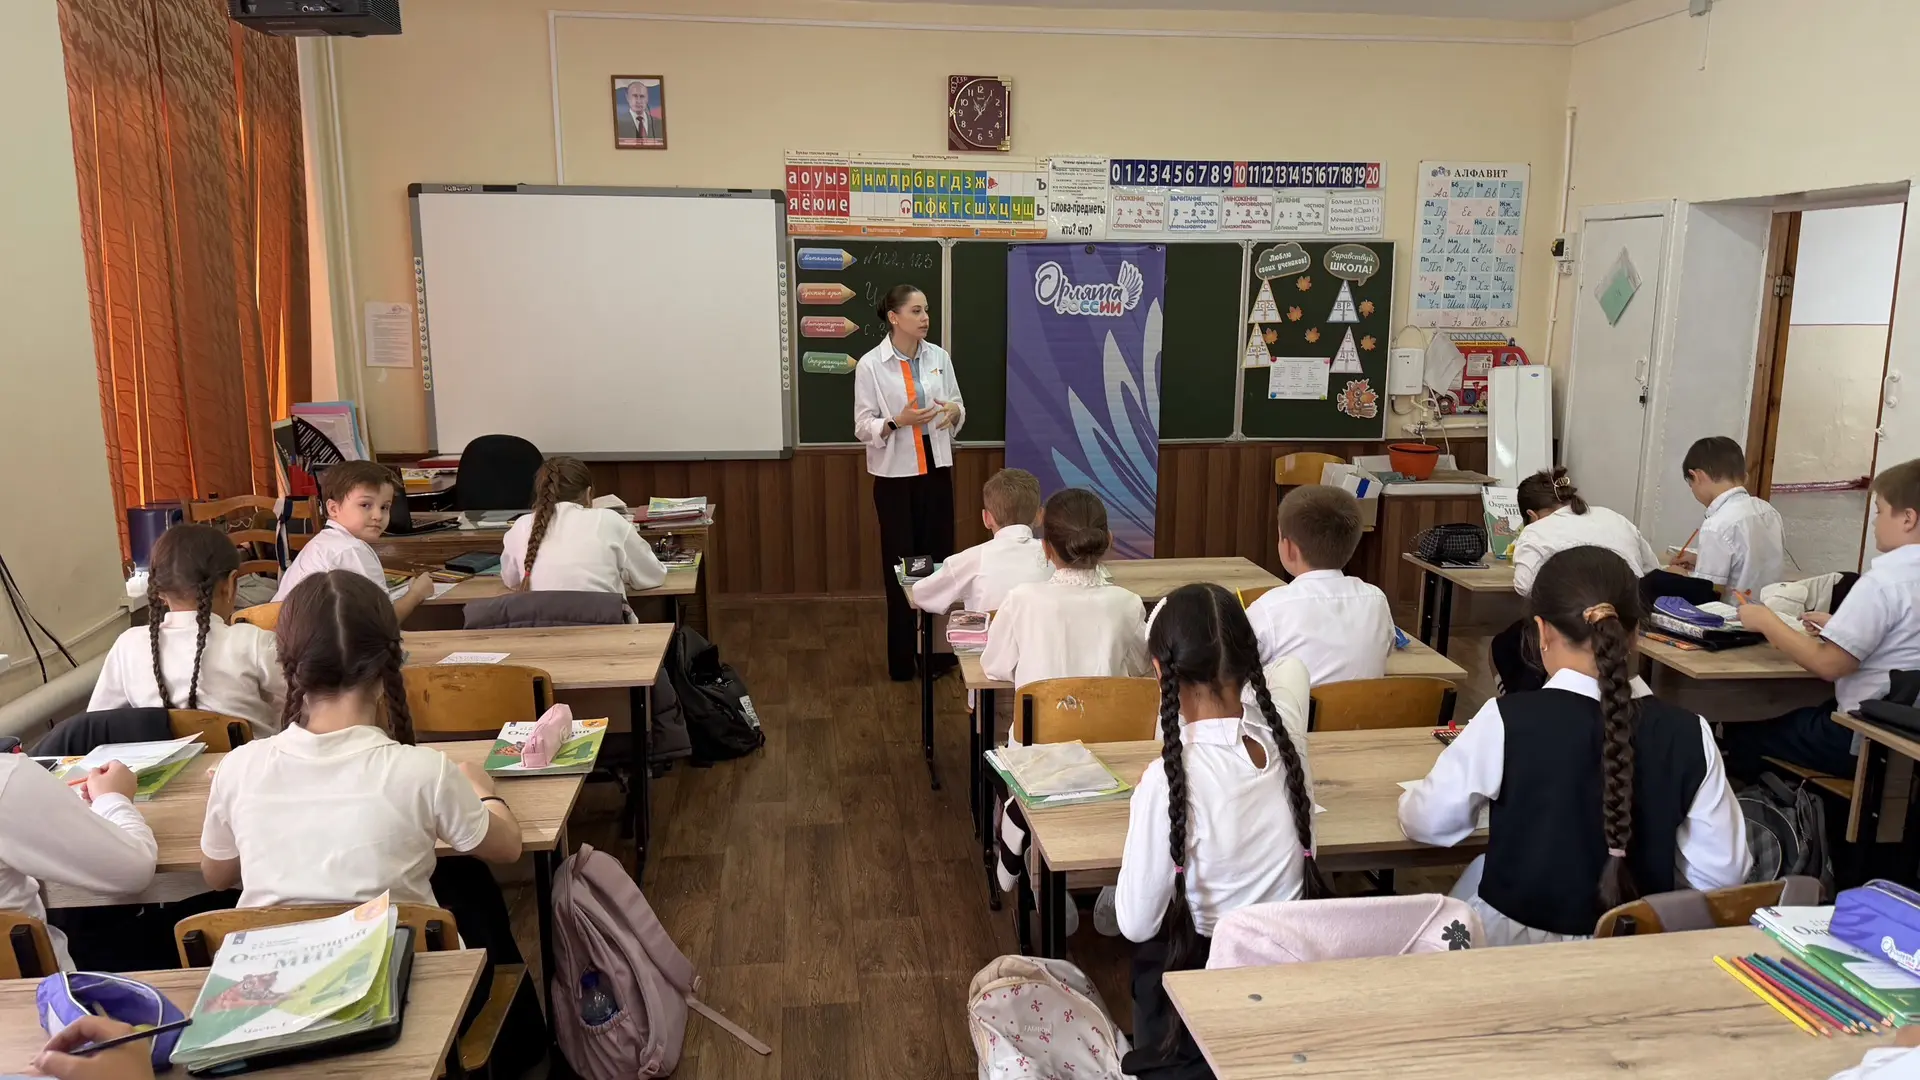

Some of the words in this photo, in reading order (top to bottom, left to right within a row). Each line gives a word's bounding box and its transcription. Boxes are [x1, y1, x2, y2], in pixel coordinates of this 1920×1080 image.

[1453, 169, 1509, 178] АЛФАВИТ
[1061, 223, 1076, 235] кто?
[1077, 224, 1093, 236] что?
[1269, 251, 1292, 262] Люблю
[1258, 264, 1276, 274] своих
[1329, 261, 1373, 274] ШКОЛА!
[1036, 262, 1123, 311] Орлята
